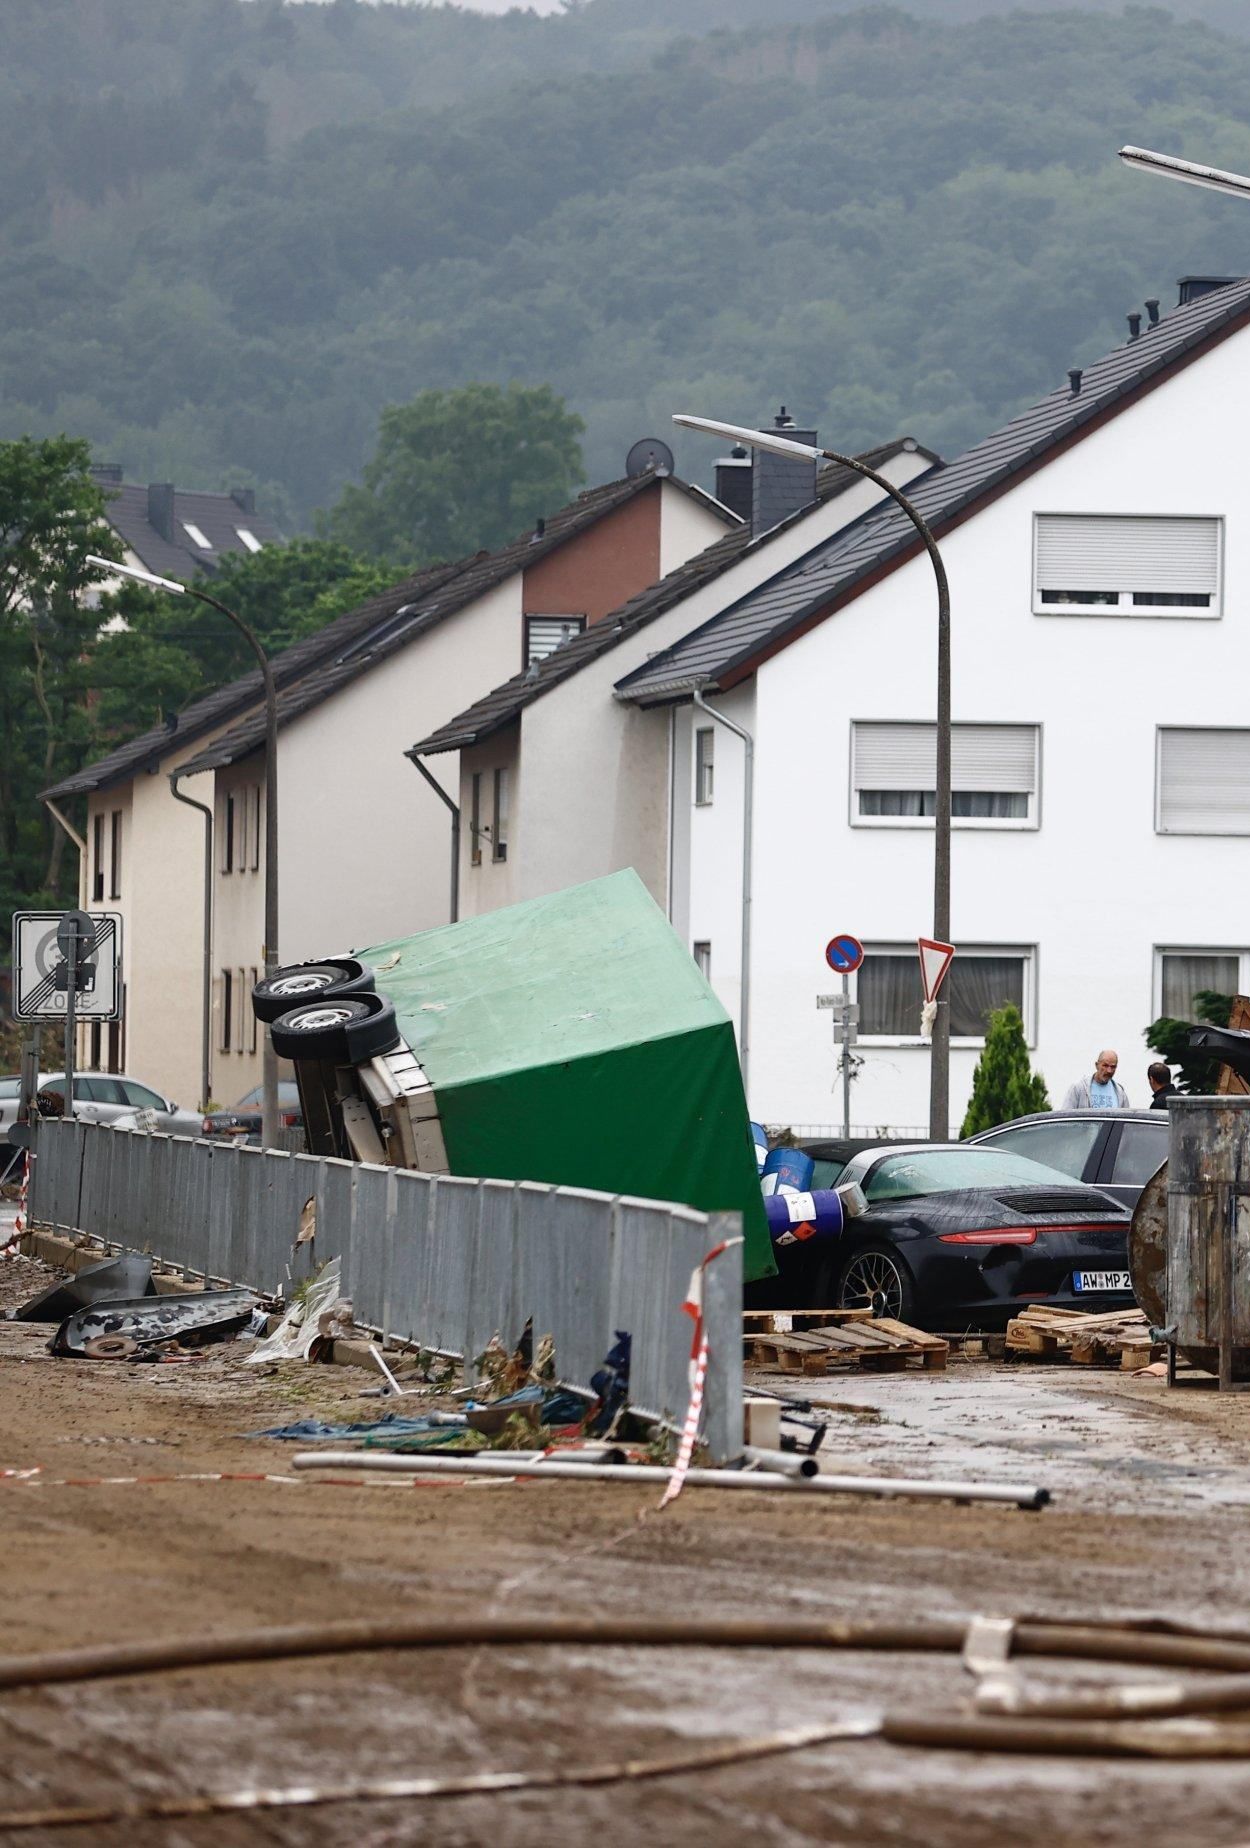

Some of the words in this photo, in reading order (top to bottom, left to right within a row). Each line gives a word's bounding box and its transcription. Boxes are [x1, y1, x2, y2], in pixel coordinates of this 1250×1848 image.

[1083, 1273, 1097, 1288] AW
[1105, 1273, 1120, 1288] MP
[1123, 1273, 1132, 1288] 2
